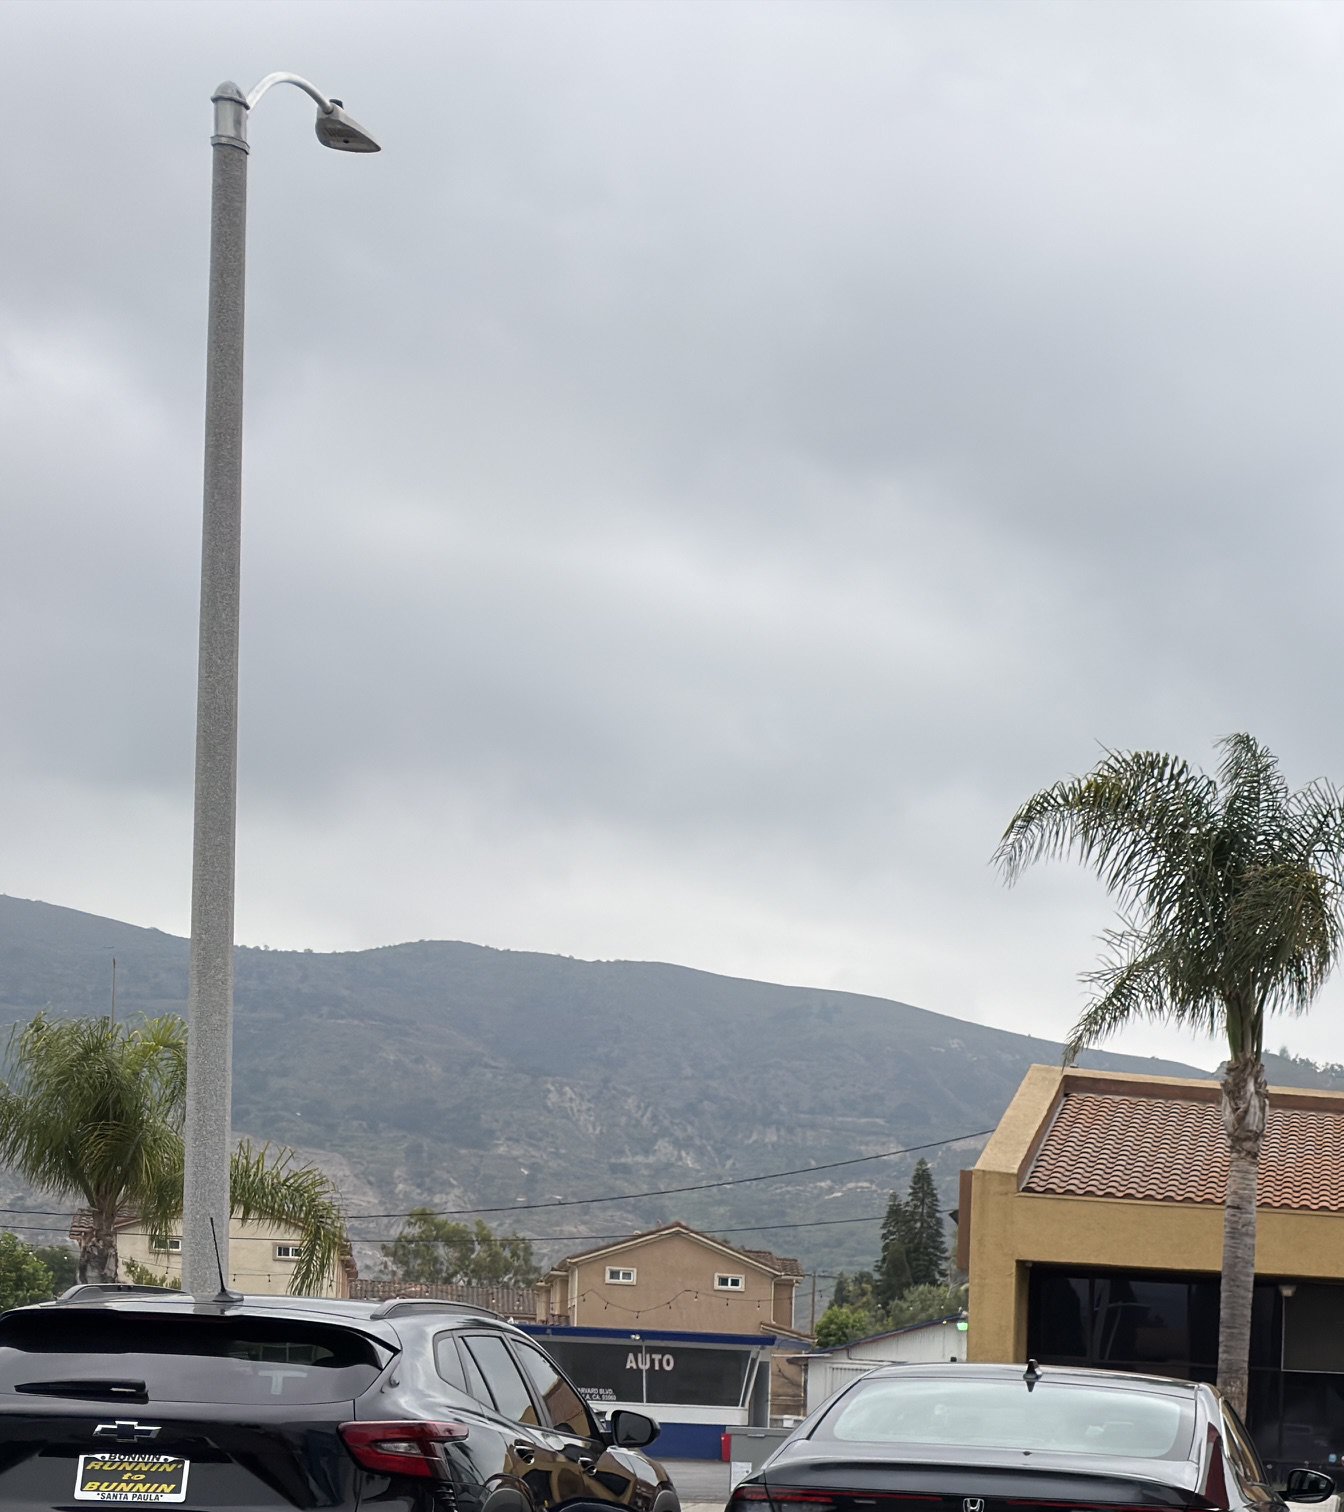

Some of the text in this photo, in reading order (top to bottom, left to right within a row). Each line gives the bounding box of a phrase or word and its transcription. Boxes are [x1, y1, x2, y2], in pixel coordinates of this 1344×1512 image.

[625, 1353, 675, 1371] AUTO
[86, 1461, 182, 1472] RUNNIN'
[121, 1472, 146, 1480] to
[83, 1481, 176, 1493] BUNNIN
